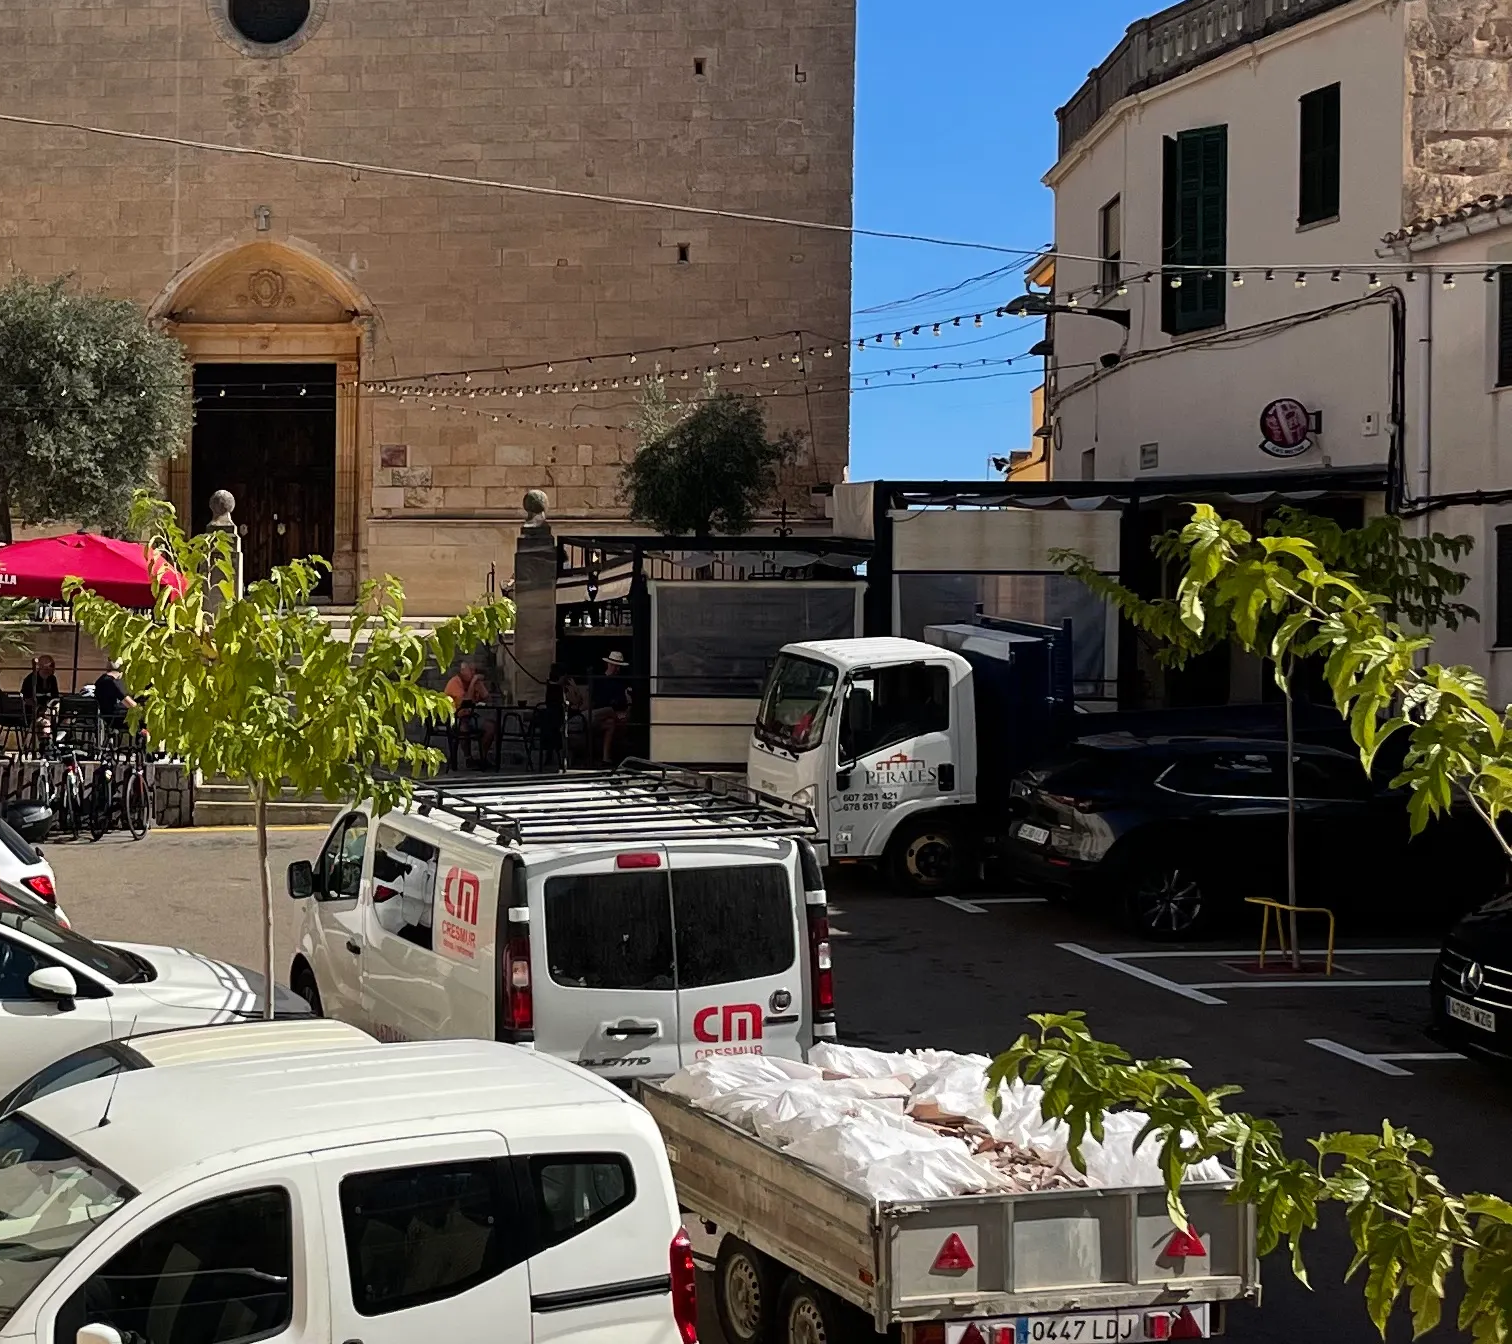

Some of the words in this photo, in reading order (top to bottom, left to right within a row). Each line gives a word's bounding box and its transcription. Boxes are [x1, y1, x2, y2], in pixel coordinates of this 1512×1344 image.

[865, 766, 937, 785] PERALES
[882, 792, 898, 800] 421
[441, 920, 476, 948] CRESMUR
[693, 1003, 764, 1043] CM
[569, 1057, 651, 1067] ALENTO
[1033, 1320, 1086, 1341] 0447
[1093, 1319, 1132, 1340] LDJ
